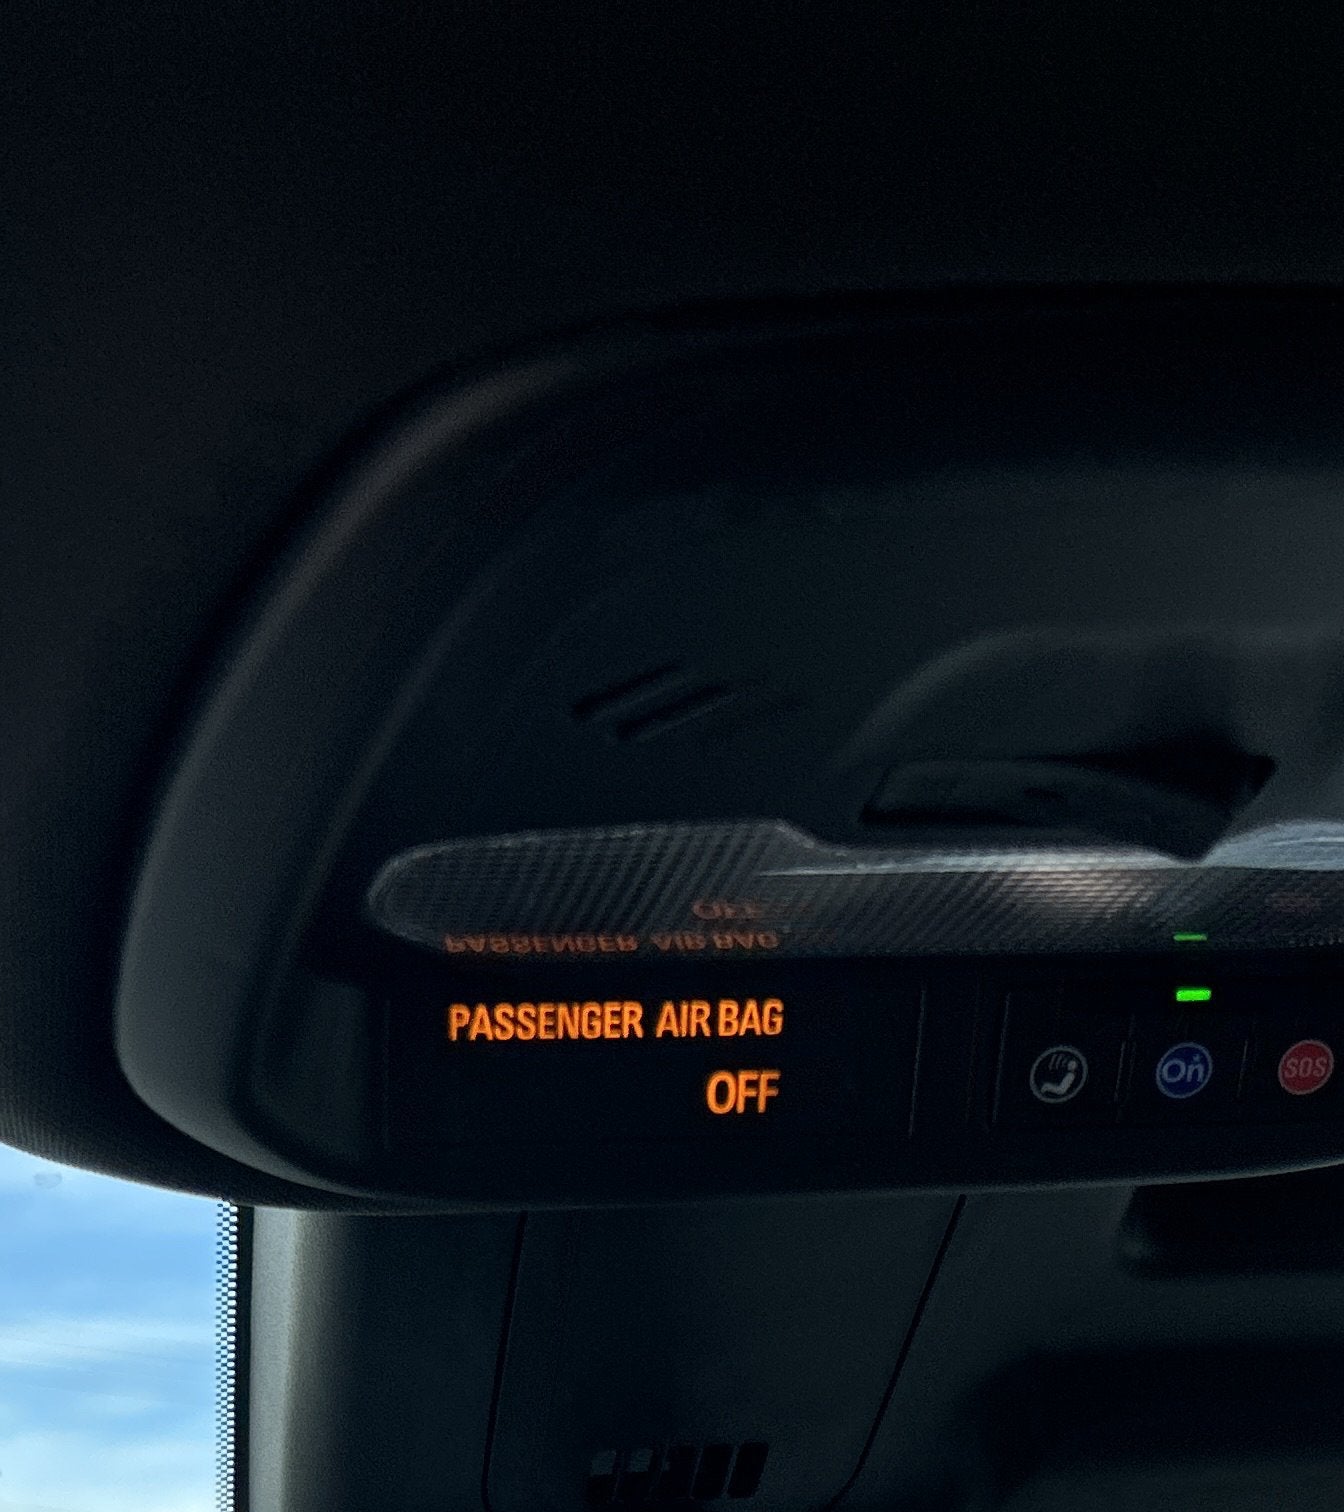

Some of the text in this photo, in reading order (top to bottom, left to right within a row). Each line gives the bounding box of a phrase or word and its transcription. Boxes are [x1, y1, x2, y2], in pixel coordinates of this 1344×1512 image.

[448, 999, 784, 1041] PASSENGER AIR BAG
[1284, 1057, 1328, 1079] SOS
[706, 1069, 782, 1114] OFF
